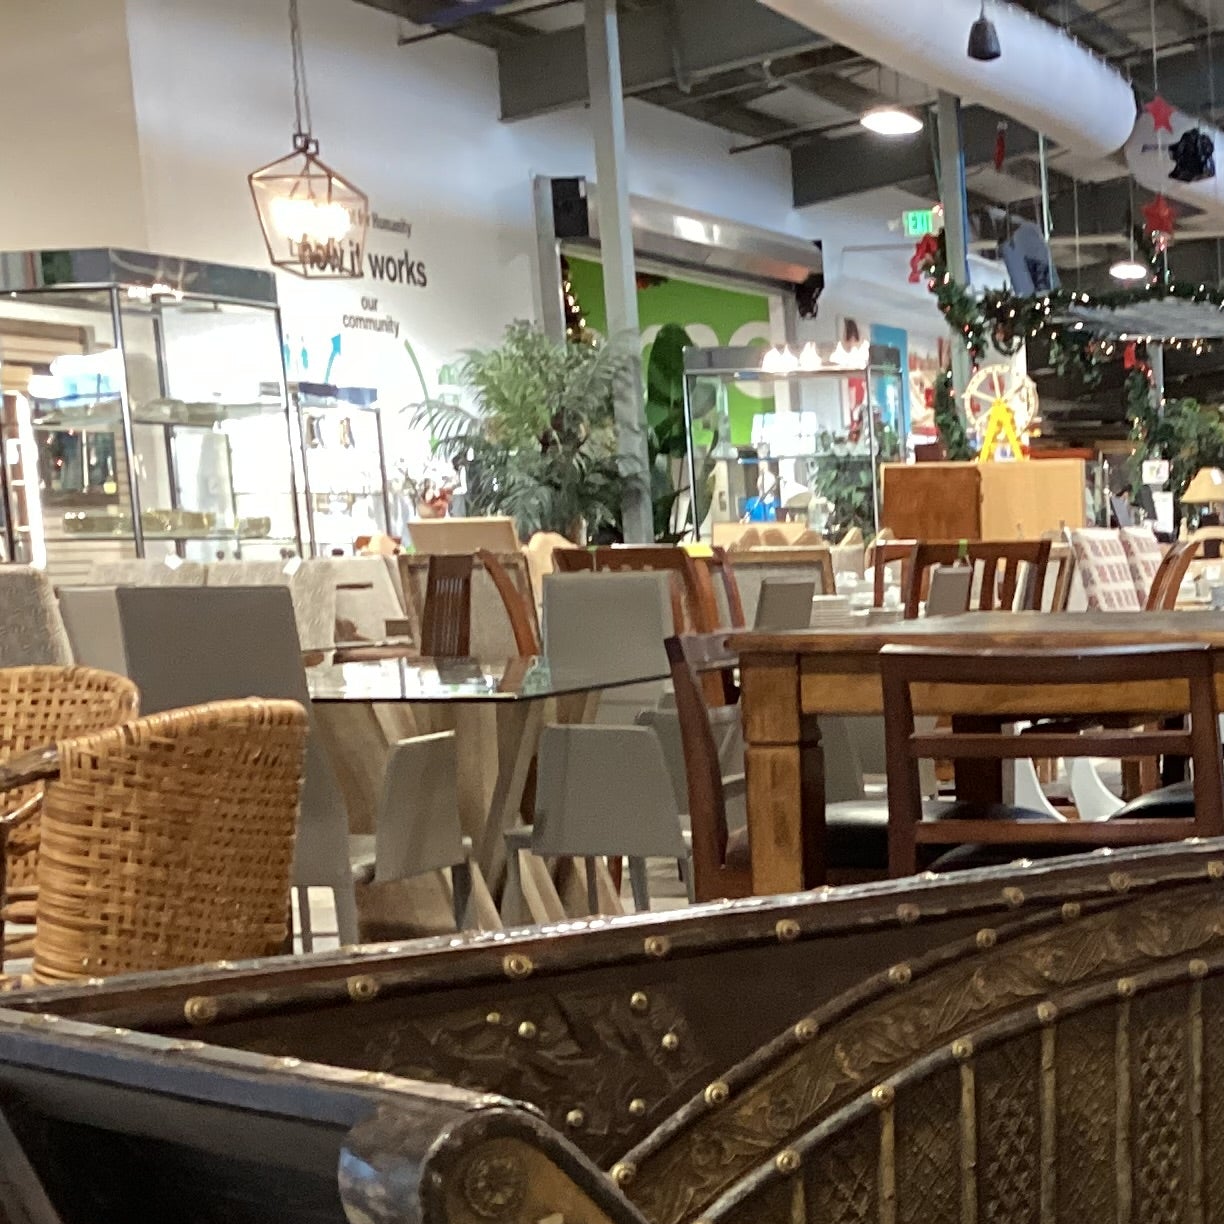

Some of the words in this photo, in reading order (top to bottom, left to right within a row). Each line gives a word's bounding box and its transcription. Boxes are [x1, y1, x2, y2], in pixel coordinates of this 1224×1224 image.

[368, 248, 427, 287] works
[361, 296, 378, 311] our
[342, 314, 400, 339] community
